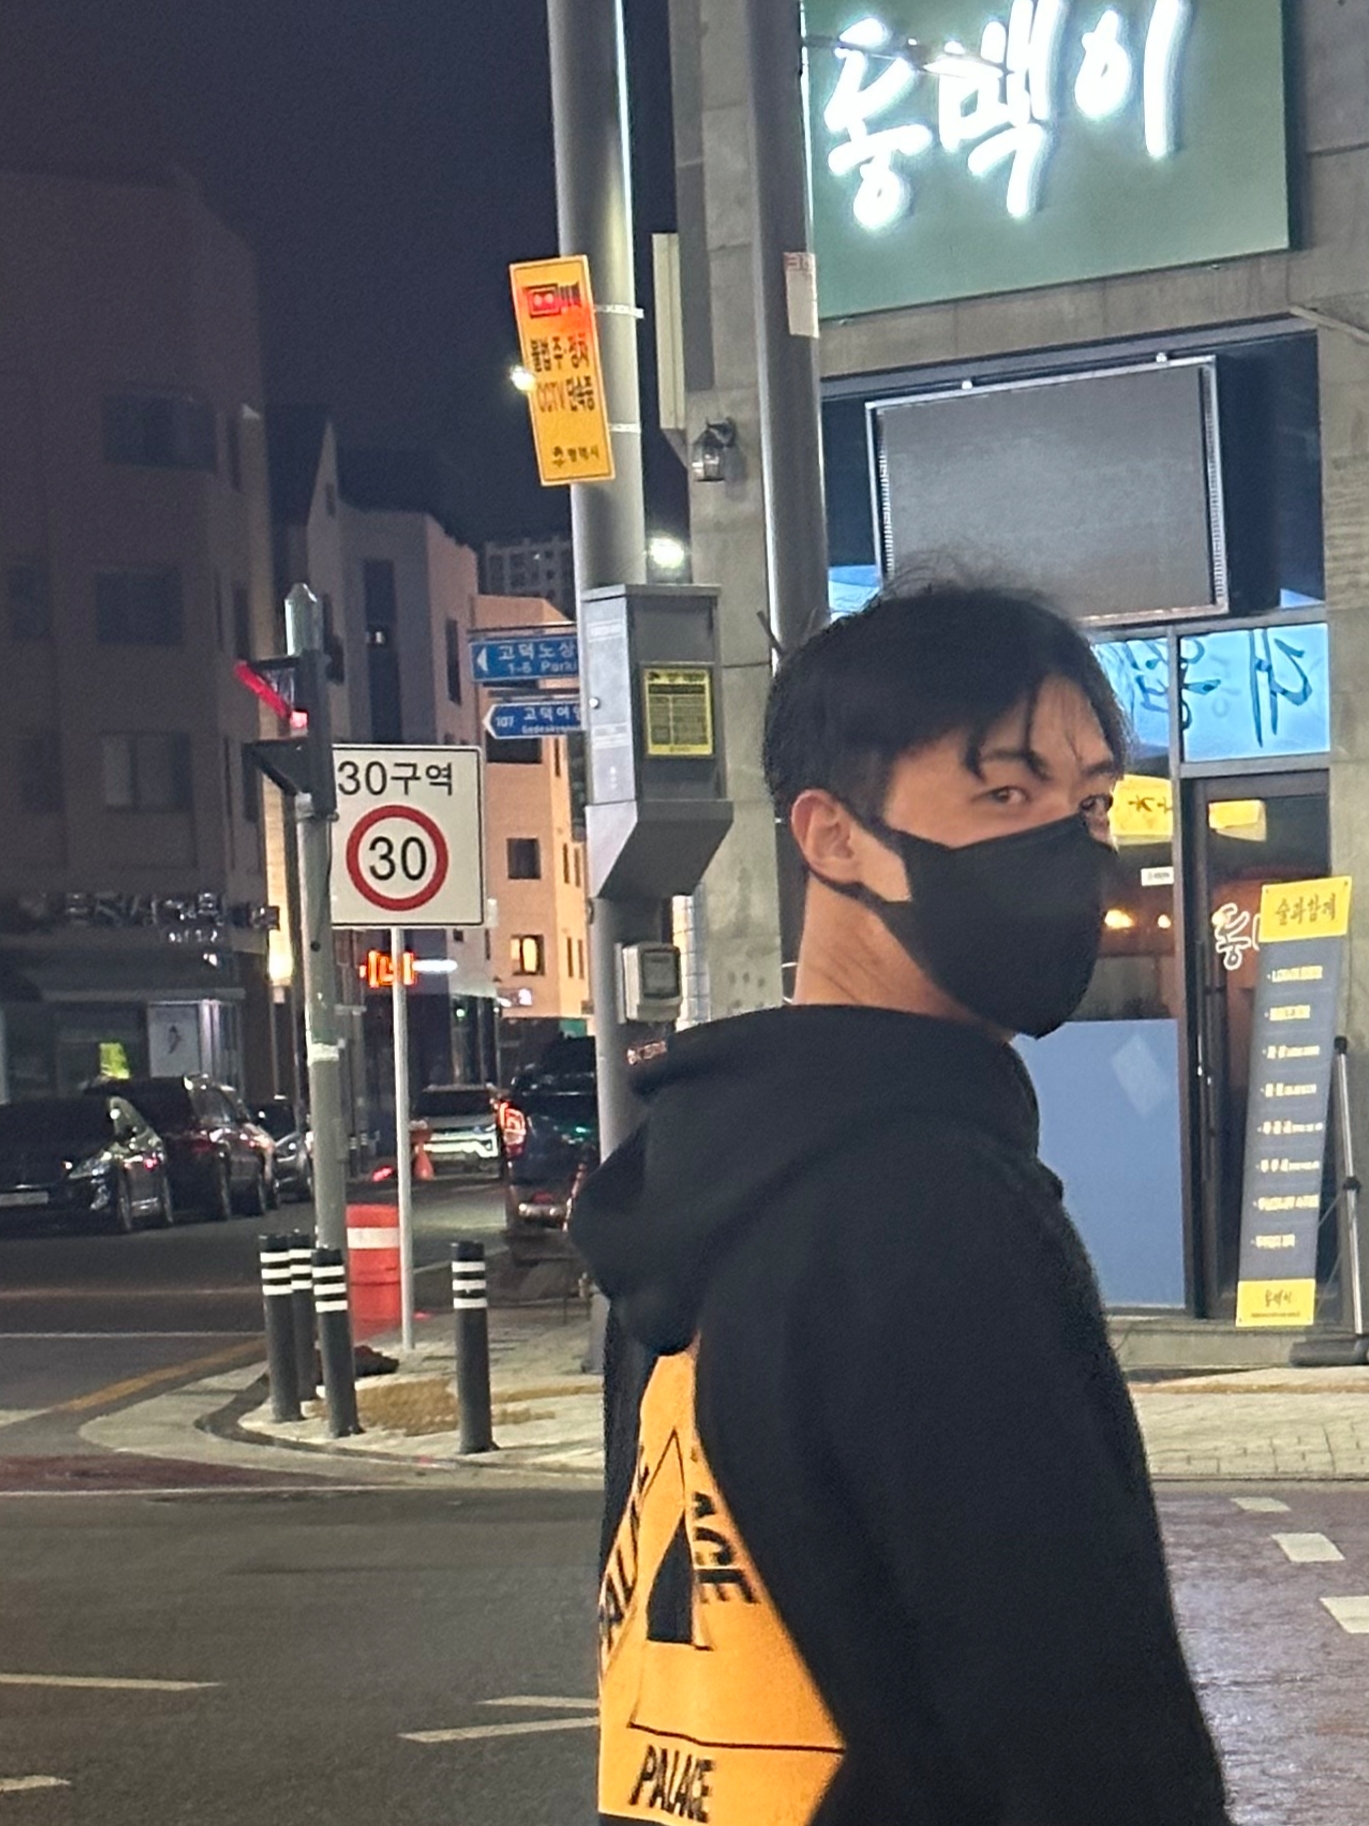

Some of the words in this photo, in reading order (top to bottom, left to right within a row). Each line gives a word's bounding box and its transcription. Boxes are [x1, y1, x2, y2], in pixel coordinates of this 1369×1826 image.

[824, 0, 1186, 229] 동백이
[337, 761, 453, 796] 30구역
[368, 836, 428, 881] 30
